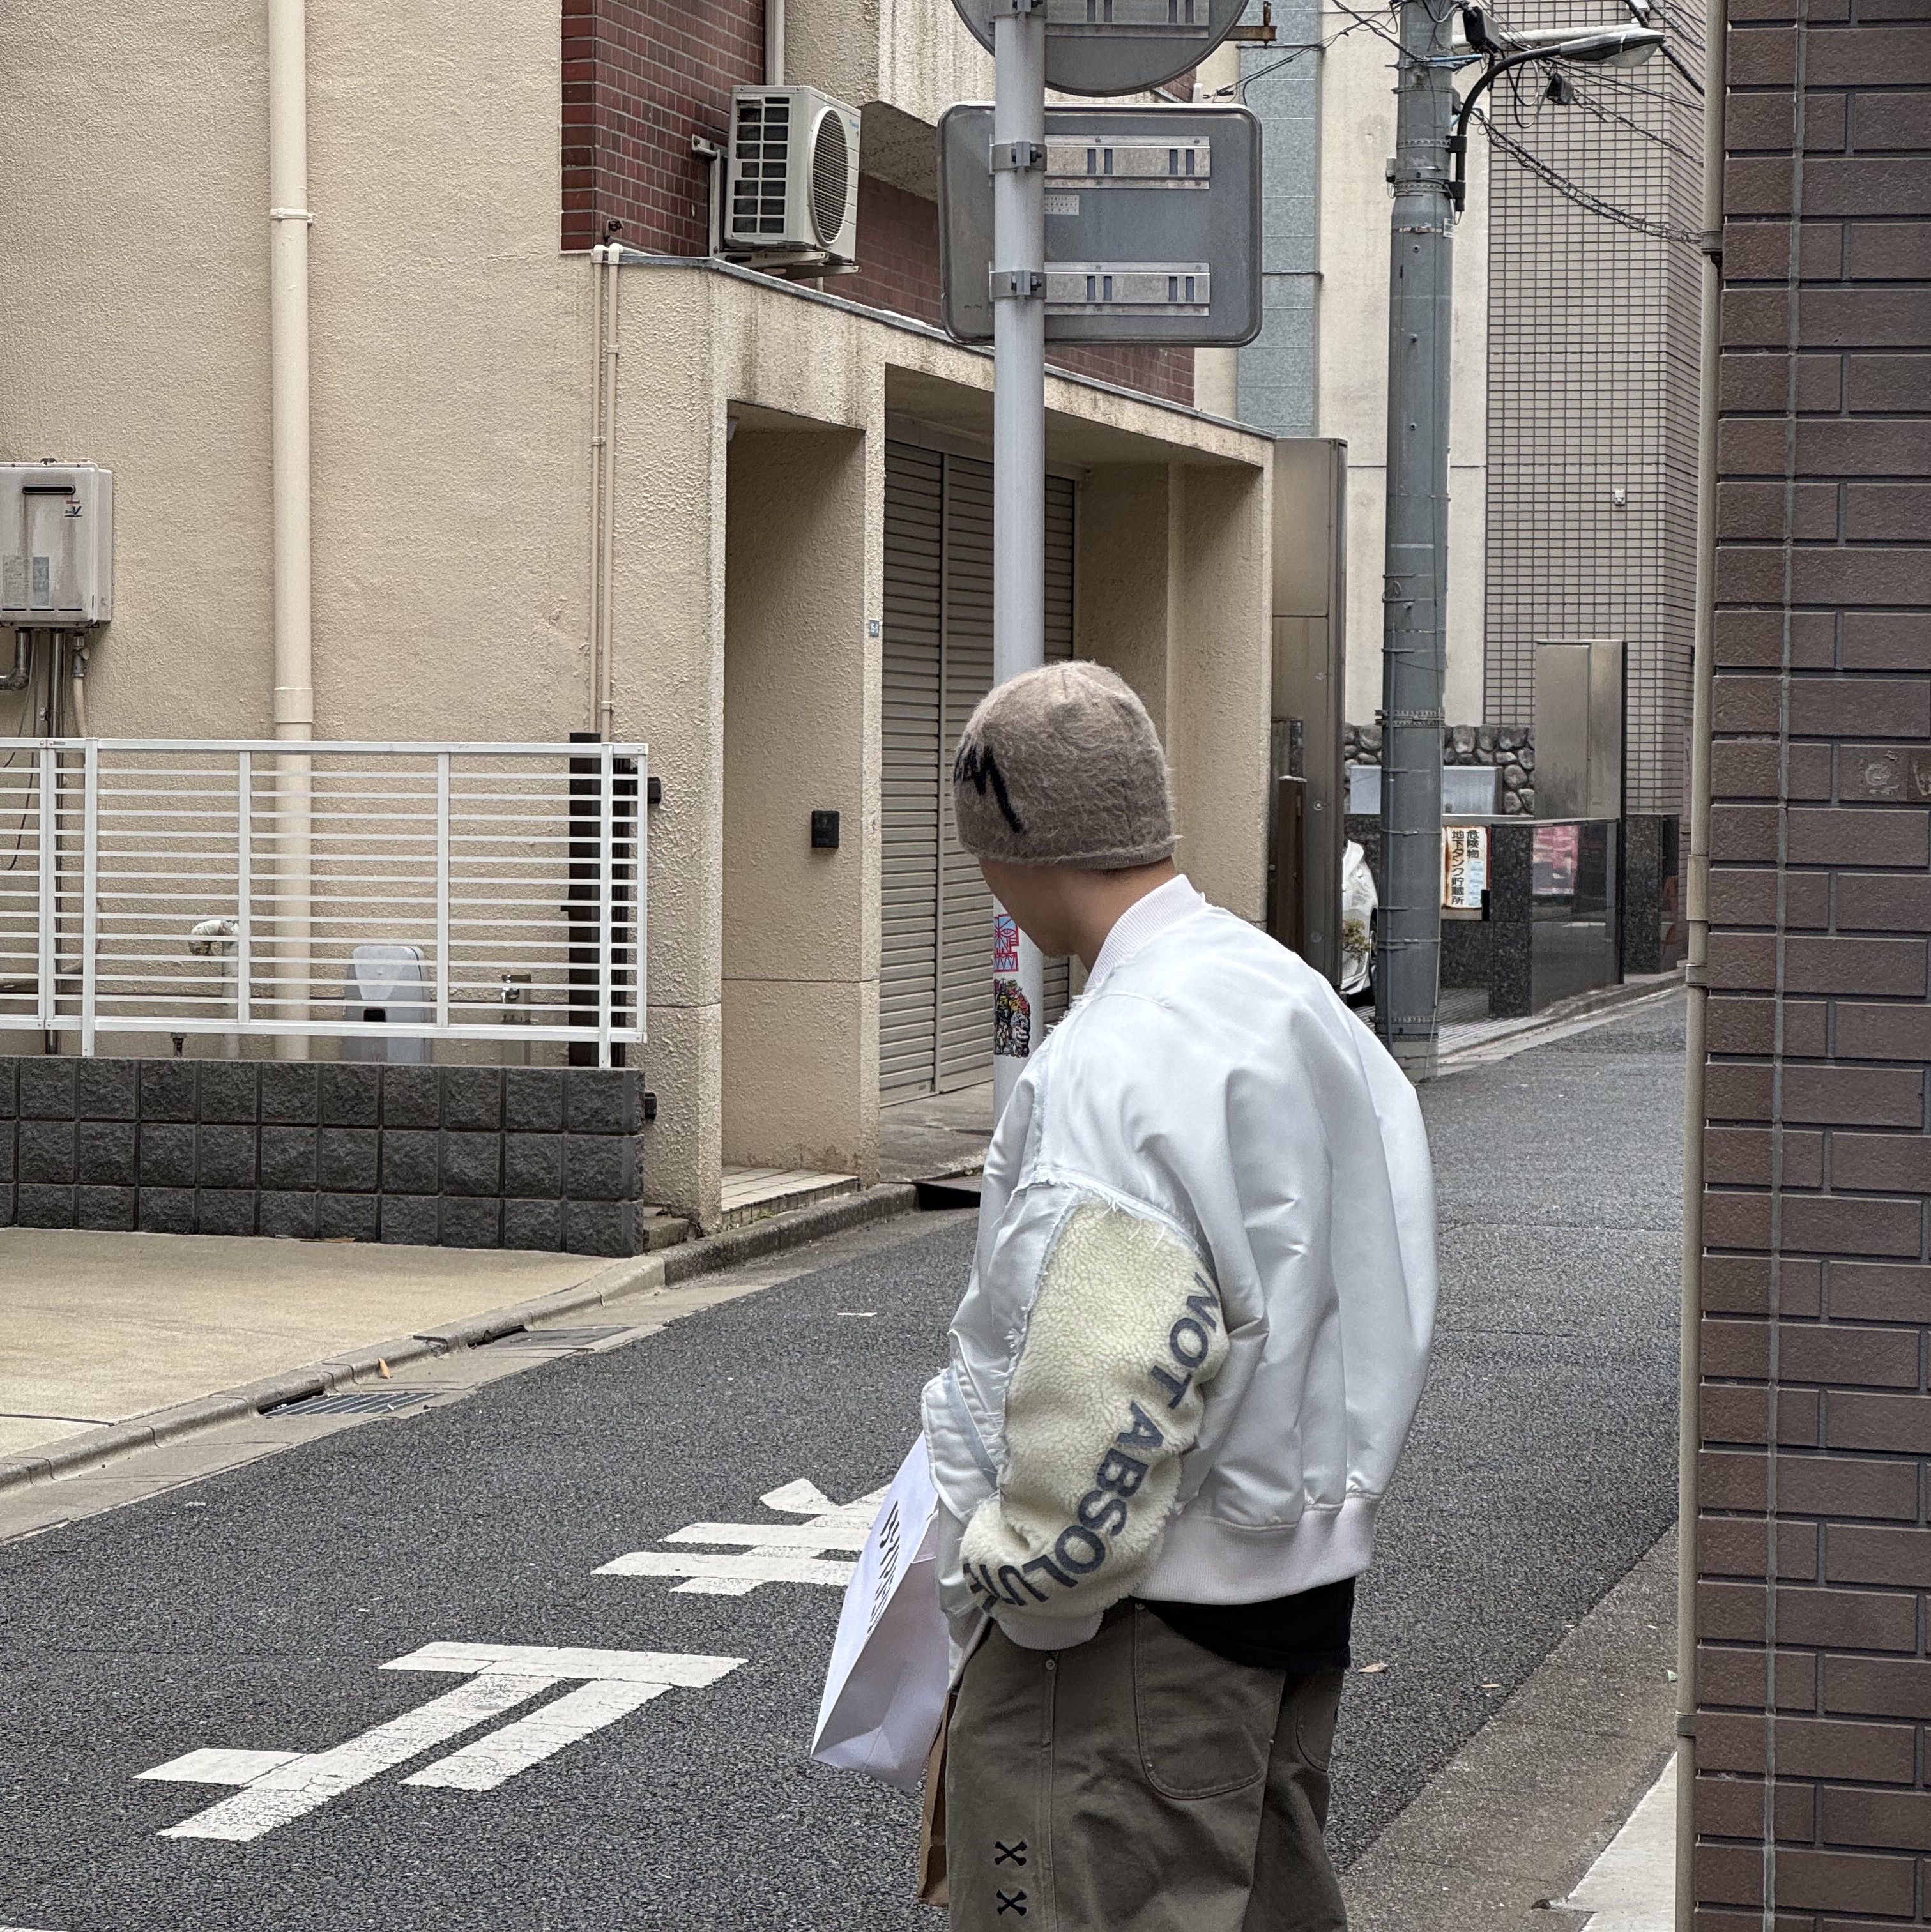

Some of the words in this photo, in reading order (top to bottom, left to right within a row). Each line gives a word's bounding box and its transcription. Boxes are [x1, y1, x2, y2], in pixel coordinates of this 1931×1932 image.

[1451, 830, 1465, 905] 地下タンク貯蔵所
[1467, 830, 1479, 859] 危険物
[1151, 1272, 1219, 1410] NOT
[867, 1500, 900, 1635] BYRED
